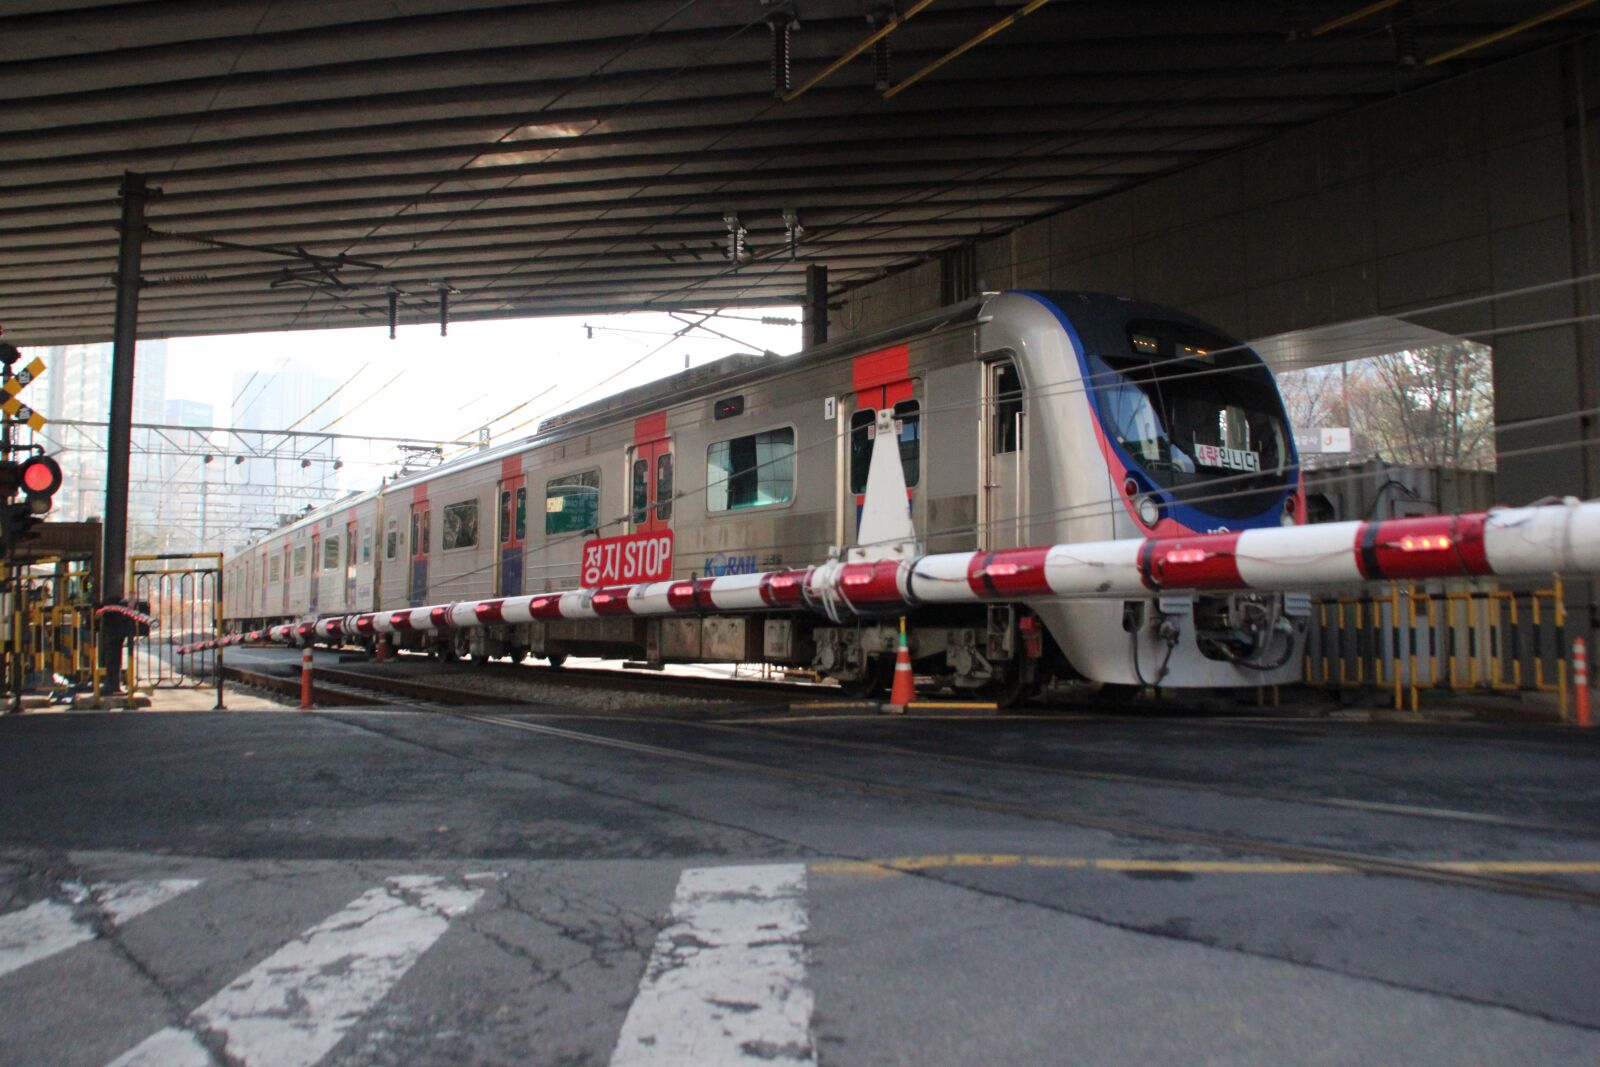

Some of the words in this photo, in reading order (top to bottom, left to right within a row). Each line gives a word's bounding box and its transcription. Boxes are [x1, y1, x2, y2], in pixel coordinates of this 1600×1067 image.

[585, 542, 621, 583] 정지
[624, 537, 671, 578] STOP
[704, 552, 758, 577] KORAIL
